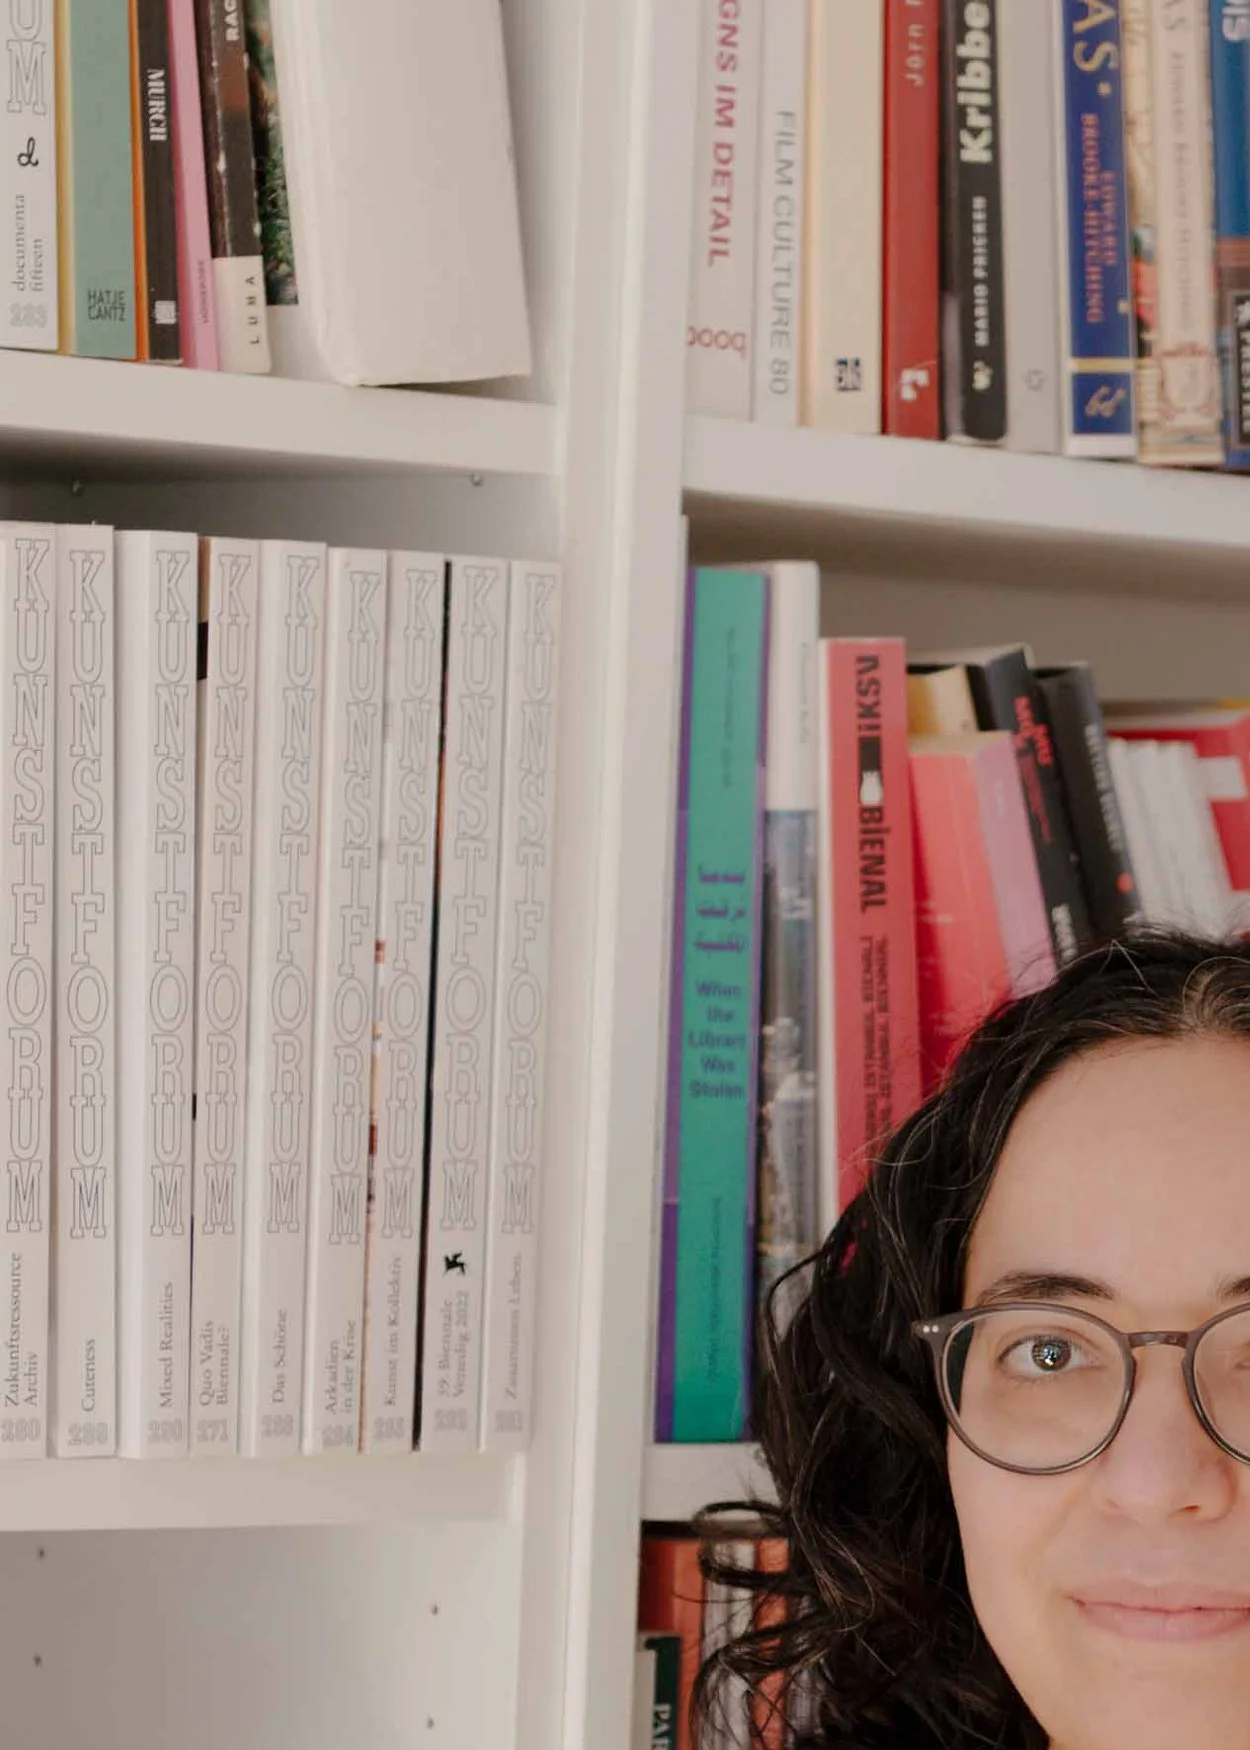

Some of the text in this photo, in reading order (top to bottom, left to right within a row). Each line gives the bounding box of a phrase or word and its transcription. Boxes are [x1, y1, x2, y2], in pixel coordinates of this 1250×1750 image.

[148, 68, 167, 142] MURCH
[713, 84, 737, 129] IM
[15, 194, 26, 291] documenta
[706, 141, 736, 268] DETAIL
[972, 196, 988, 279] PRICKEN
[1081, 113, 1106, 325] BROOKE-HITCHING
[1101, 171, 1118, 268] EDWARD
[30, 238, 43, 291] fifteen
[88, 288, 126, 307] HATJE
[769, 110, 796, 395] FILM CULTURE 80
[88, 306, 126, 322] CANTZ
[247, 275, 260, 346] LUMA
[973, 283, 989, 347] MARIO
[7, 538, 50, 1233] KUNSTFORUM
[67, 550, 108, 1239] KUNSTFORUM
[150, 550, 191, 1237] KUNSTFORUM
[203, 554, 251, 1235] KUNSTFORUM
[267, 555, 320, 1233] KUNSTFORUM
[329, 571, 381, 1245] KUNSTFORUM
[381, 568, 437, 1240] KUNSTFORUM
[440, 565, 498, 1231] KUNSTFORUM
[502, 573, 556, 1234] KUNSTFORUM
[697, 980, 741, 998] When
[4, 1251, 22, 1408] Zukunftsressource
[81, 1338, 96, 1413] Cuteness
[159, 1281, 174, 1408] Mixed Realities
[199, 1320, 214, 1407] Quo Vadis
[215, 1326, 231, 1406] Biennale?
[271, 1309, 289, 1404] Das Schöne
[324, 1339, 340, 1414] Arkadien
[341, 1319, 356, 1415] in der Krise
[383, 1257, 402, 1407] Kunst im Kollektiv
[436, 1298, 452, 1370] Biennale
[451, 1332, 469, 1398] Venedig
[505, 1309, 521, 1400] Zusammen
[23, 1351, 38, 1408] Archiv
